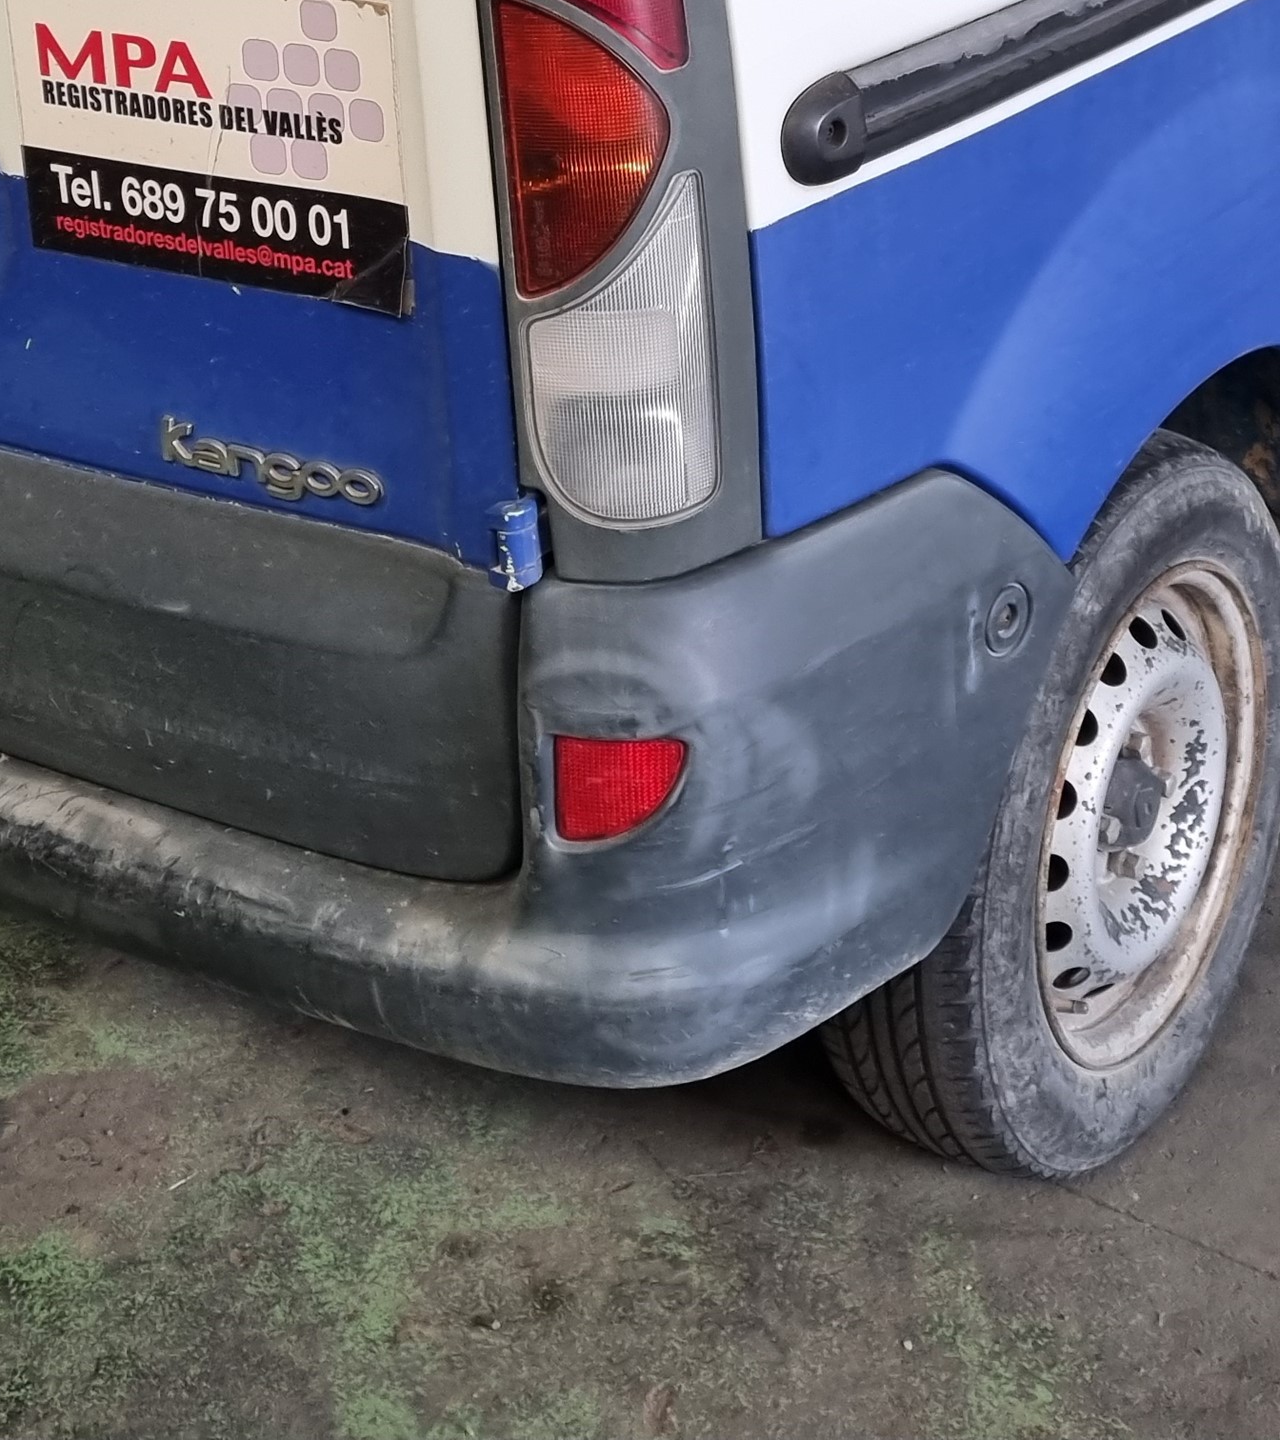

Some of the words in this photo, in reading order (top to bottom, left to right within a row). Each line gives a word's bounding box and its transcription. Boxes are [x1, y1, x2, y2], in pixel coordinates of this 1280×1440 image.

[35, 22, 213, 100] MPA
[41, 79, 214, 129] REGISTRADORES
[219, 103, 259, 135] DEL
[262, 110, 344, 145] VALLÈS
[49, 163, 112, 211] Tel.
[121, 176, 185, 224] 689
[195, 188, 241, 232] 75
[251, 196, 297, 241] 00
[308, 204, 350, 249] 01
[56, 215, 355, 279] registradoresdelvalles@mpa.cat
